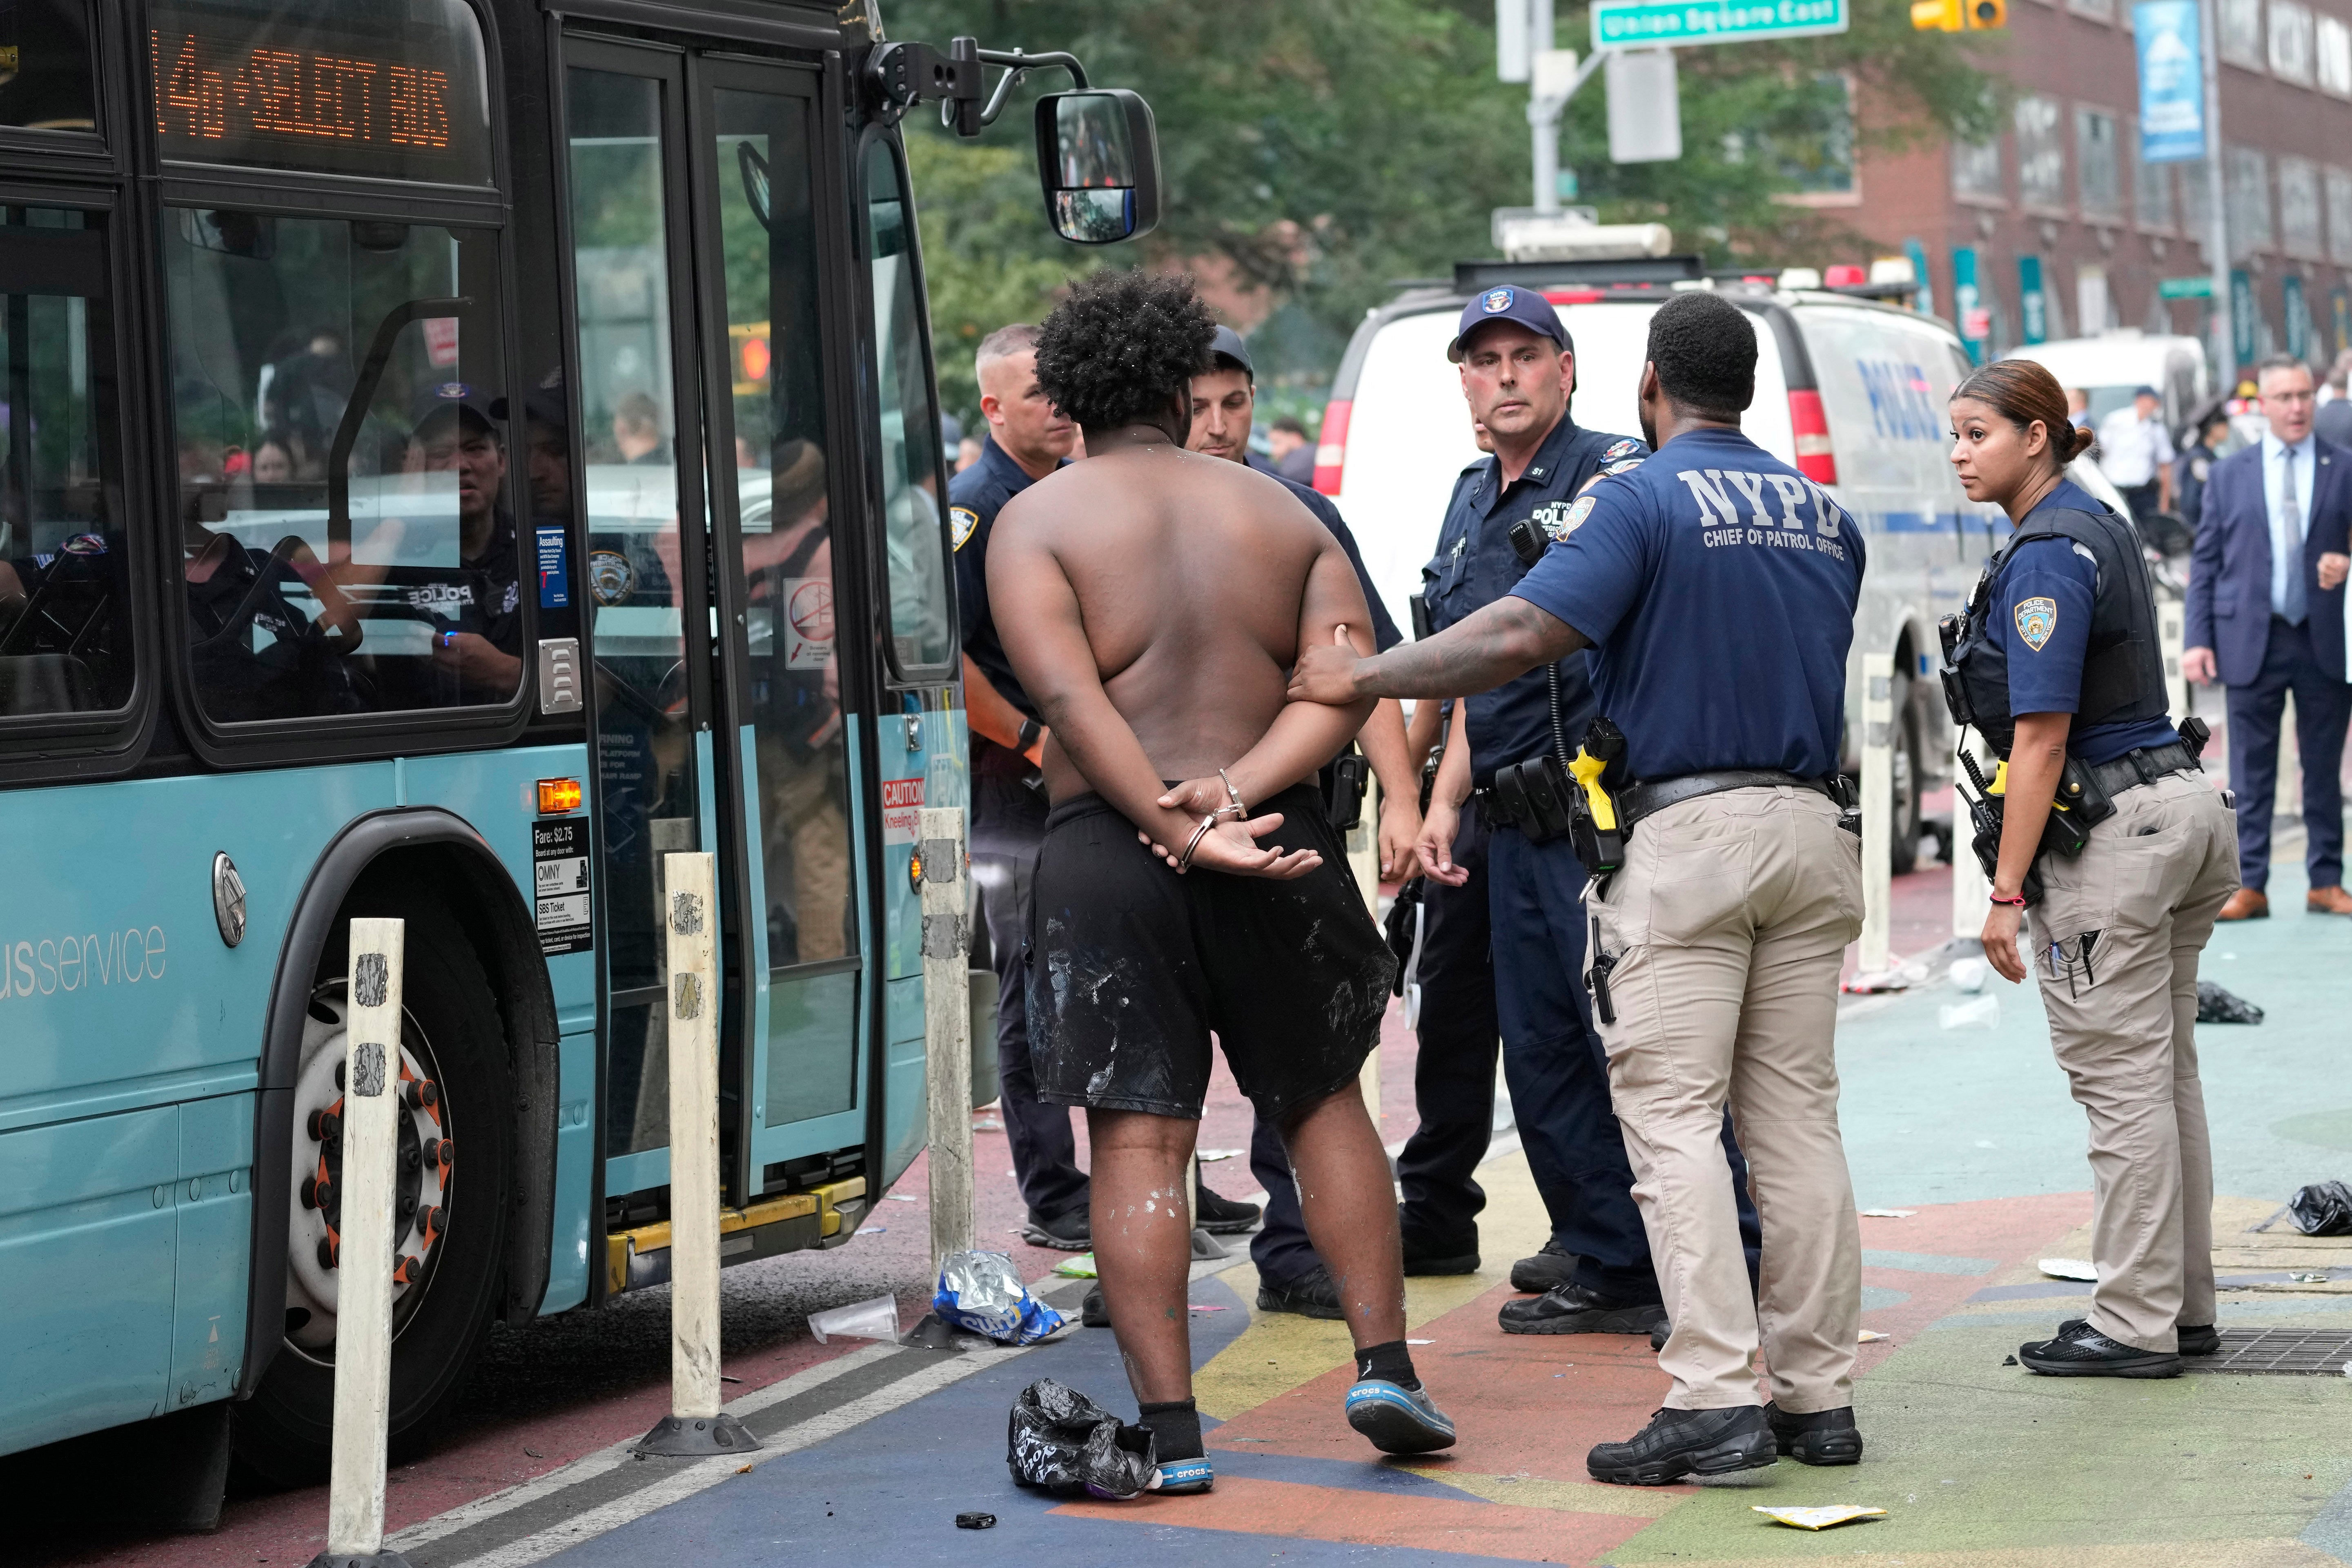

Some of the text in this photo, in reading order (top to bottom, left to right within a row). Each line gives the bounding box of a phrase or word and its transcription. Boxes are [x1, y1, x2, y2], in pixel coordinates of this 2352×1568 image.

[1603, 0, 1834, 38] Union Square East
[391, 67, 448, 147] BUS
[1676, 469, 1841, 538] NYPD
[1532, 508, 1568, 525] POLI
[1513, 524, 1523, 533] NYPD
[539, 536, 563, 548] Assaulting
[1704, 528, 1844, 561] CHIEF OF PATROL OFFICE
[541, 571, 547, 589] 7
[2023, 599, 2045, 610] POLICE
[2018, 606, 2053, 620] DEPARTMENT
[2040, 632, 2048, 642] NEW
[599, 734, 633, 744] RNING
[884, 781, 924, 806] CAUTION
[884, 812, 911, 831] Kneeling
[535, 826, 572, 844] Fare: $2.75
[536, 849, 546, 857] Board
[538, 864, 560, 881] OMNY
[539, 902, 565, 914] SBS Ticket
[205, 1347, 219, 1359] JACK
[203, 1359, 219, 1371] POINT
[1352, 1388, 1380, 1397] crocs
[1177, 1468, 1205, 1478] crocs
